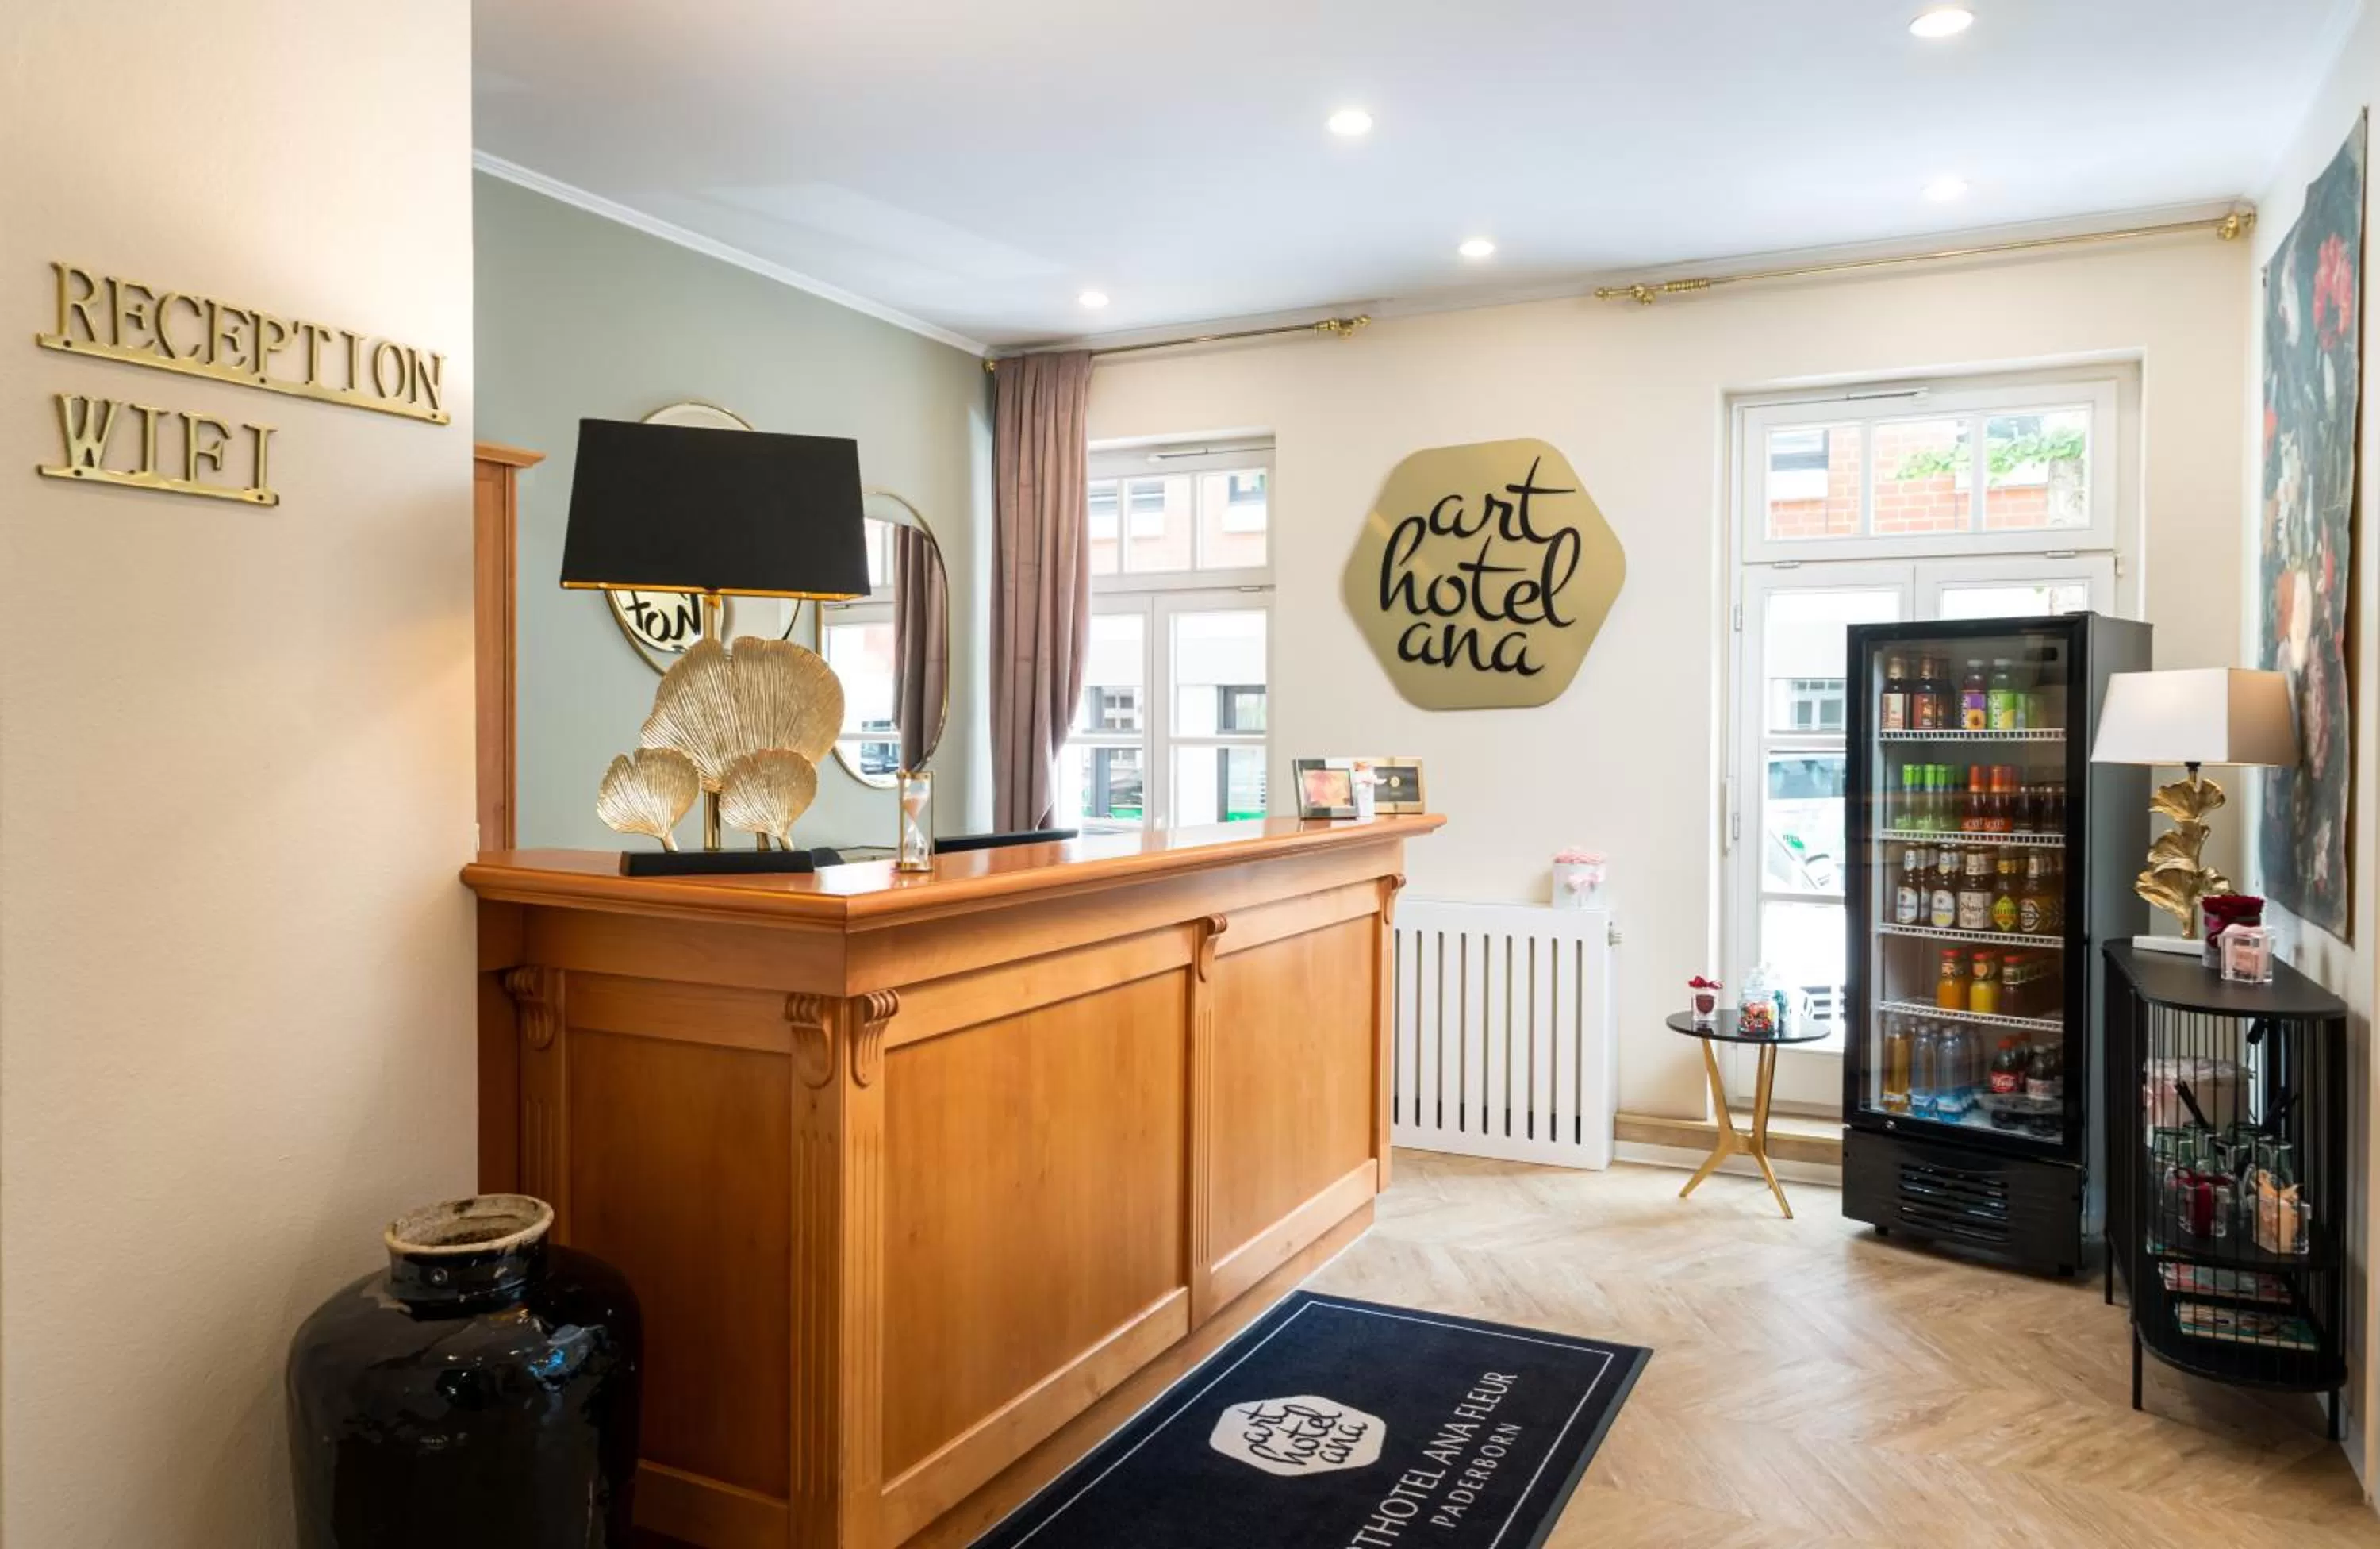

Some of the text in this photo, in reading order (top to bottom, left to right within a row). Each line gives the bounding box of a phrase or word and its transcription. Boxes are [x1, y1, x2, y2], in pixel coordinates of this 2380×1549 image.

[51, 261, 448, 413] RECEPTION
[52, 394, 278, 492] WIFI
[1429, 455, 1576, 544] art
[1380, 516, 1581, 628] hotel
[1397, 621, 1545, 676] ana
[1238, 1403, 1292, 1444] art
[1249, 1404, 1342, 1466] hotel
[1319, 1422, 1368, 1464] ana
[1346, 1371, 1518, 1549] THOTEL ANA FLEUR
[1430, 1423, 1522, 1528] PADERBORN
